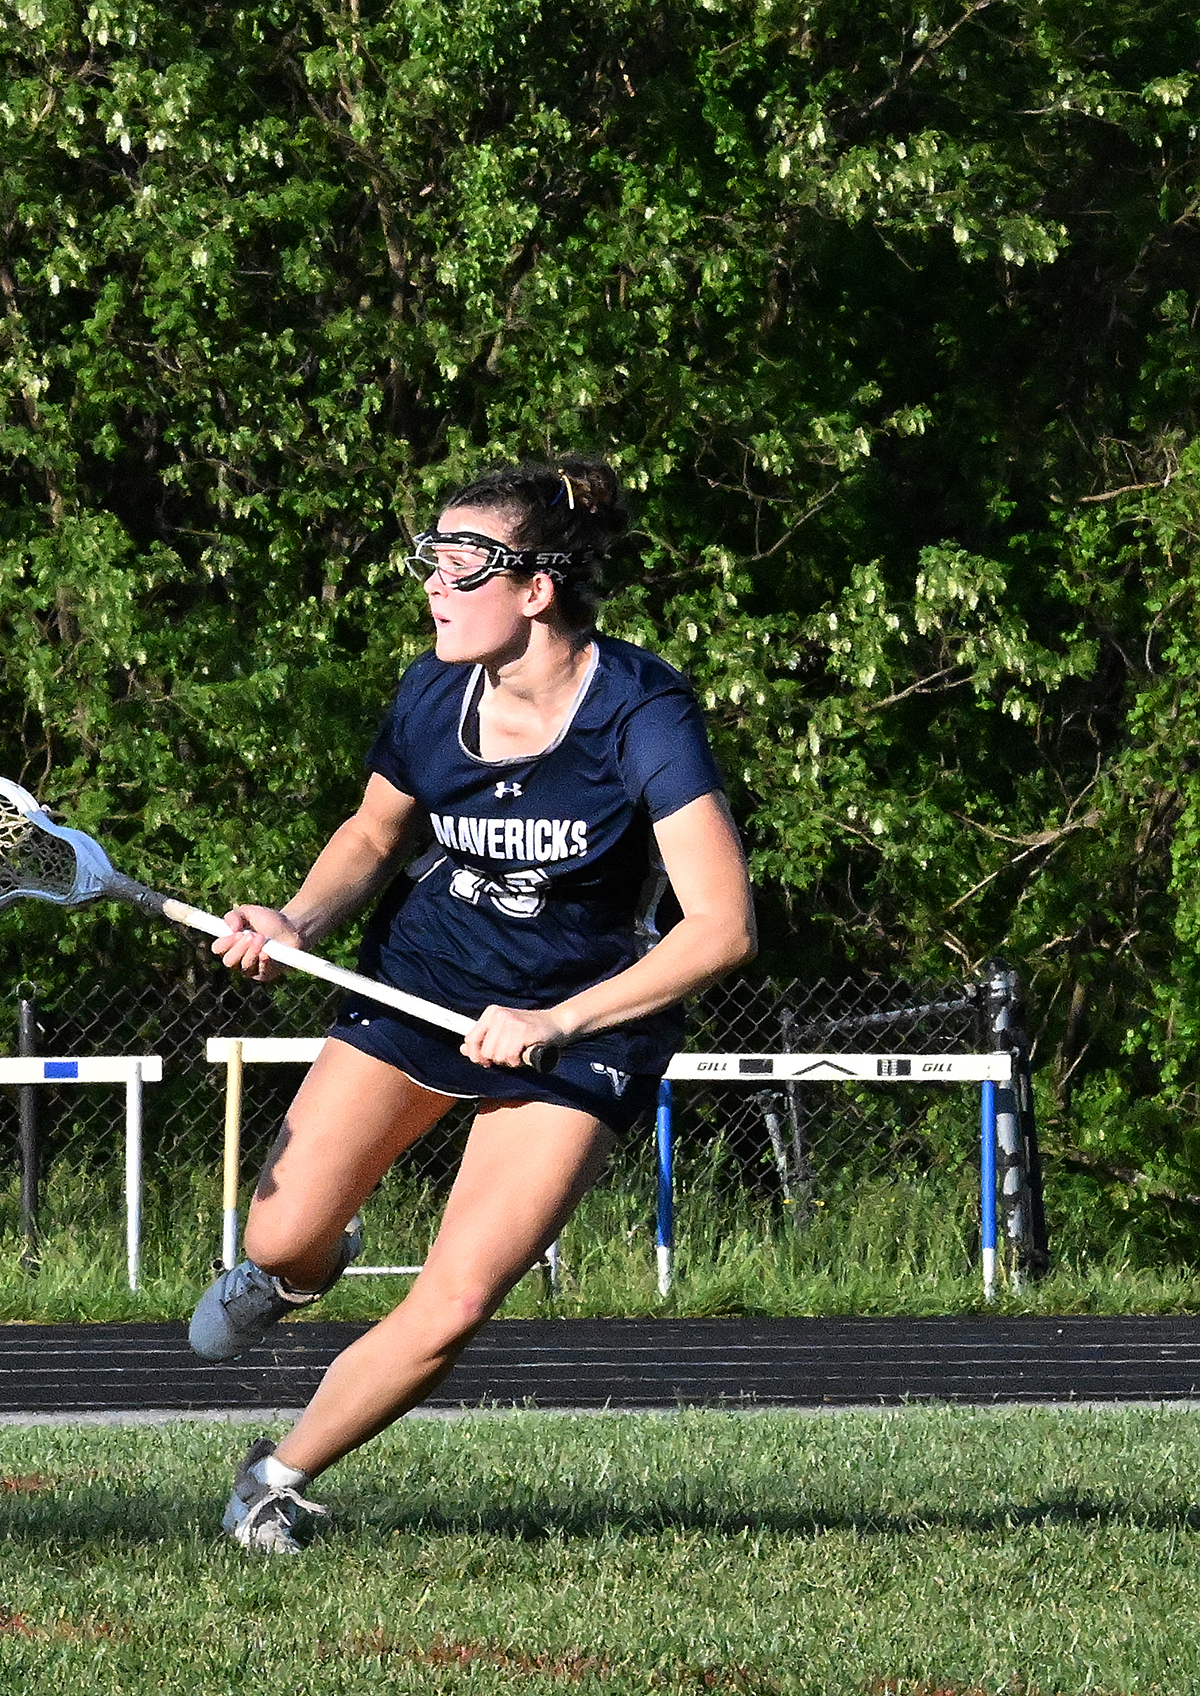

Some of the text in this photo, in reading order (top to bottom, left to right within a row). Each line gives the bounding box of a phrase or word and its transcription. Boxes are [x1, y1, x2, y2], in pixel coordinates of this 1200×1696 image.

[536, 552, 572, 565] STX
[430, 812, 588, 861] MAVERICKS
[697, 1062, 727, 1071] GILL
[922, 1063, 953, 1072] GILL
